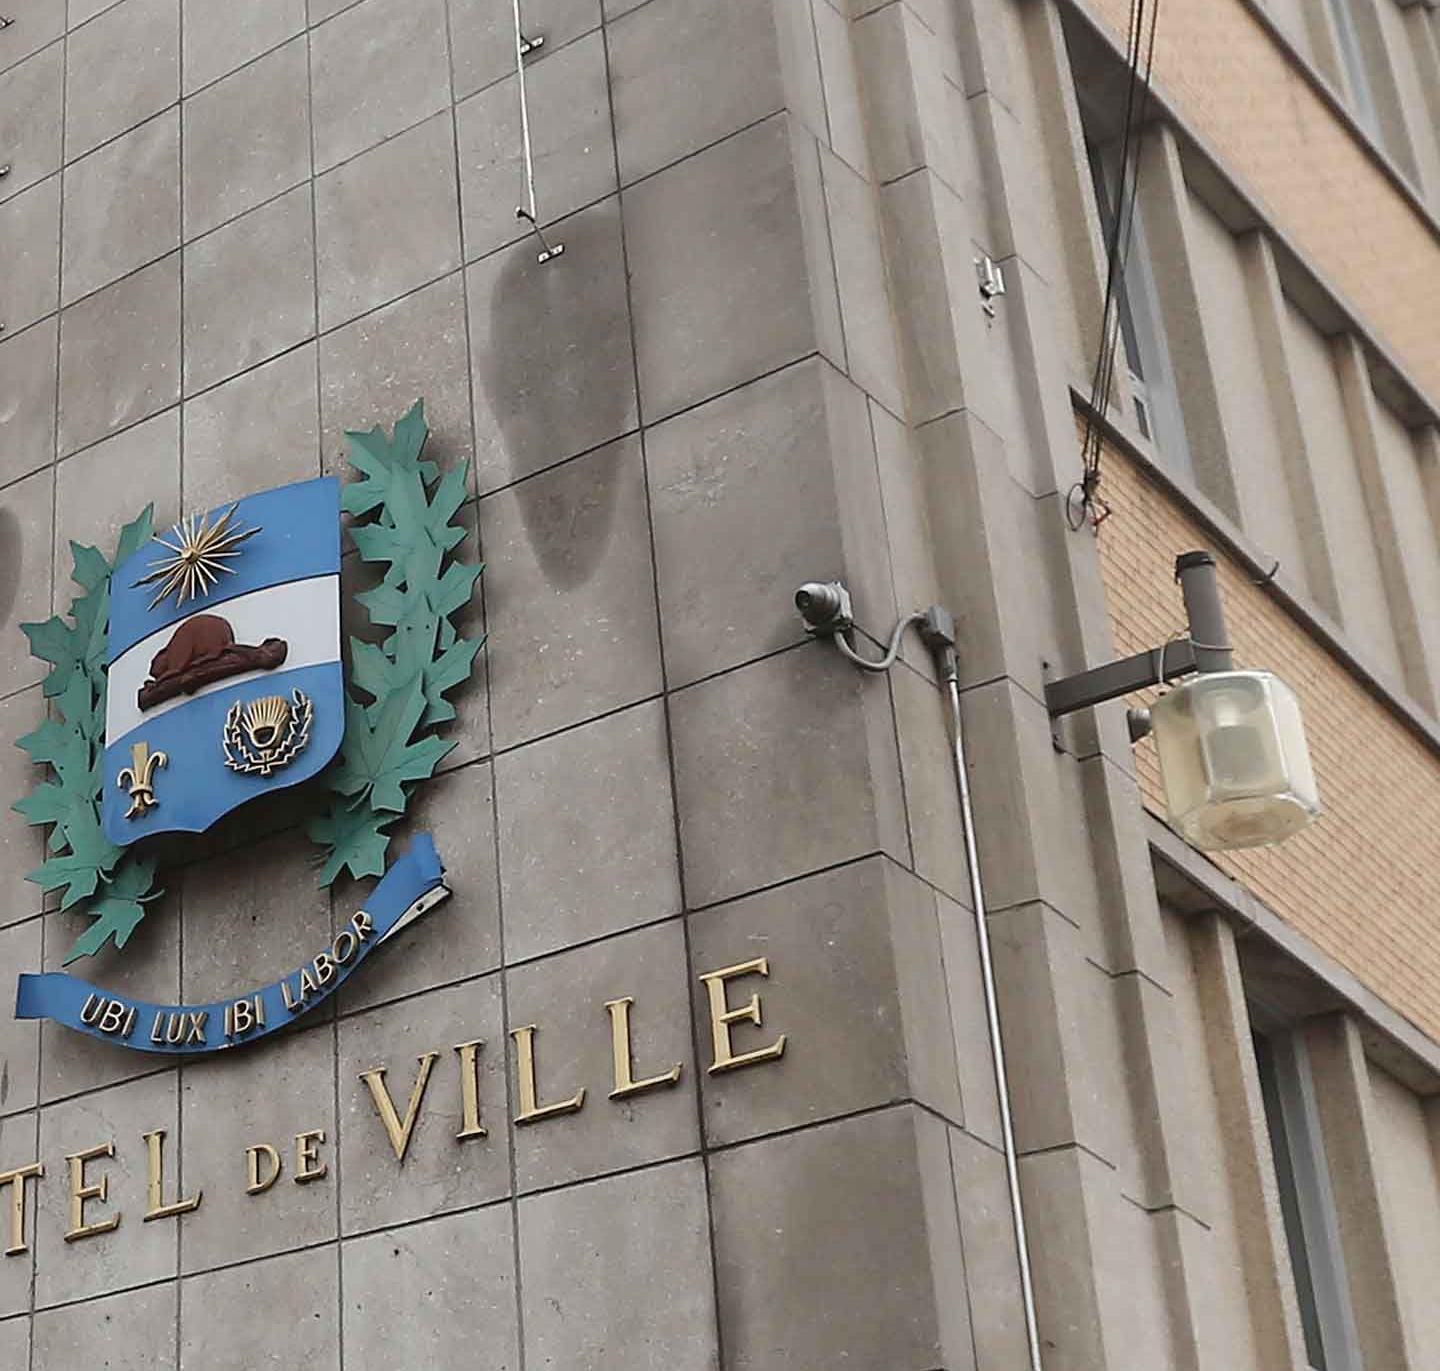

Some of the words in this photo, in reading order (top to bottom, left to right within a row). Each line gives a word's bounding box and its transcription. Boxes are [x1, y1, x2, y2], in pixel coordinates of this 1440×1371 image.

[81, 993, 138, 1037] UBI
[150, 1010, 208, 1045] LUX
[225, 995, 265, 1038] IBI
[281, 910, 372, 1013] LABOR
[245, 1129, 328, 1195] DE
[359, 957, 788, 1161] VILLE
